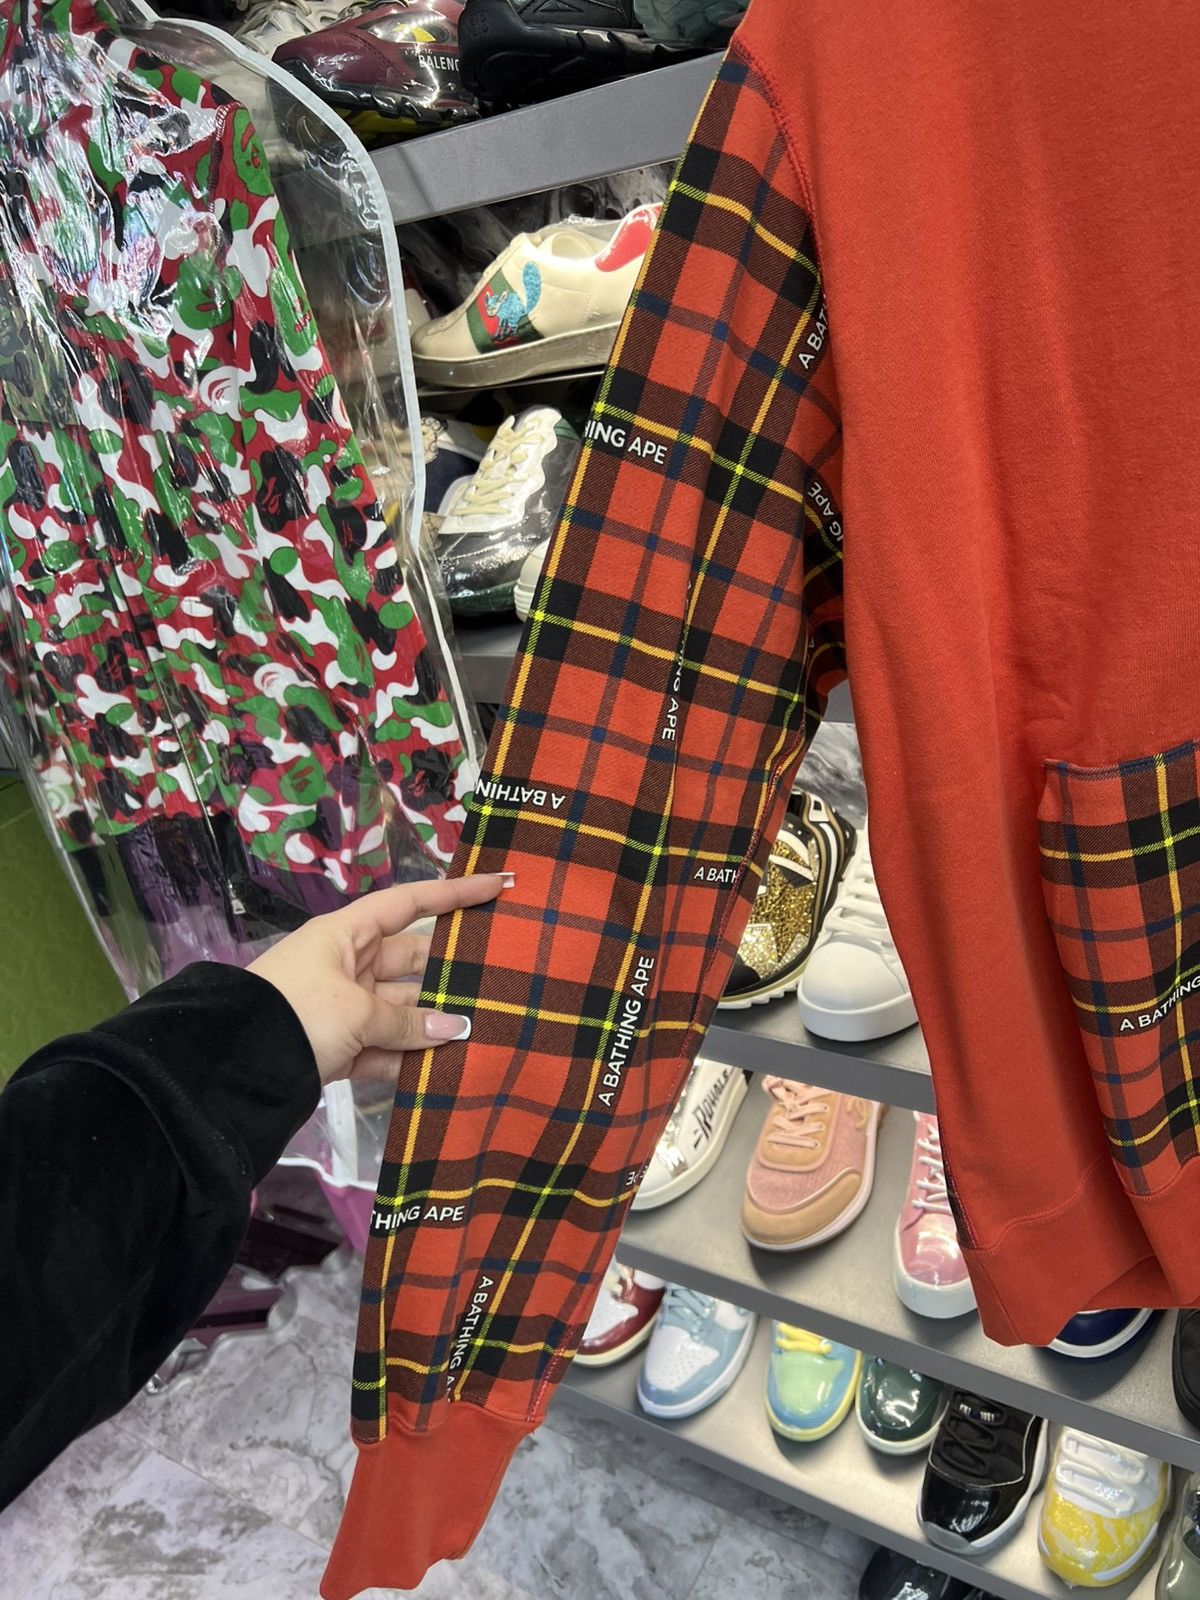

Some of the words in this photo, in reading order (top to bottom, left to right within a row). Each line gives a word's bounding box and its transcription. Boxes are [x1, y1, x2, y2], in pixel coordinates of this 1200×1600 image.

[799, 354, 815, 369] A
[627, 436, 668, 465] APE
[807, 482, 834, 516] APE
[661, 697, 679, 741] APE
[551, 793, 566, 810] A
[693, 866, 705, 880] A
[631, 956, 655, 996] APE
[1120, 1018, 1135, 1031] A
[1138, 975, 1200, 1028] BATHING
[602, 999, 642, 1088] BATHING
[598, 1092, 615, 1107] A
[424, 1205, 466, 1221] APE
[478, 1276, 494, 1289] A
[449, 1292, 488, 1370] BATHING
